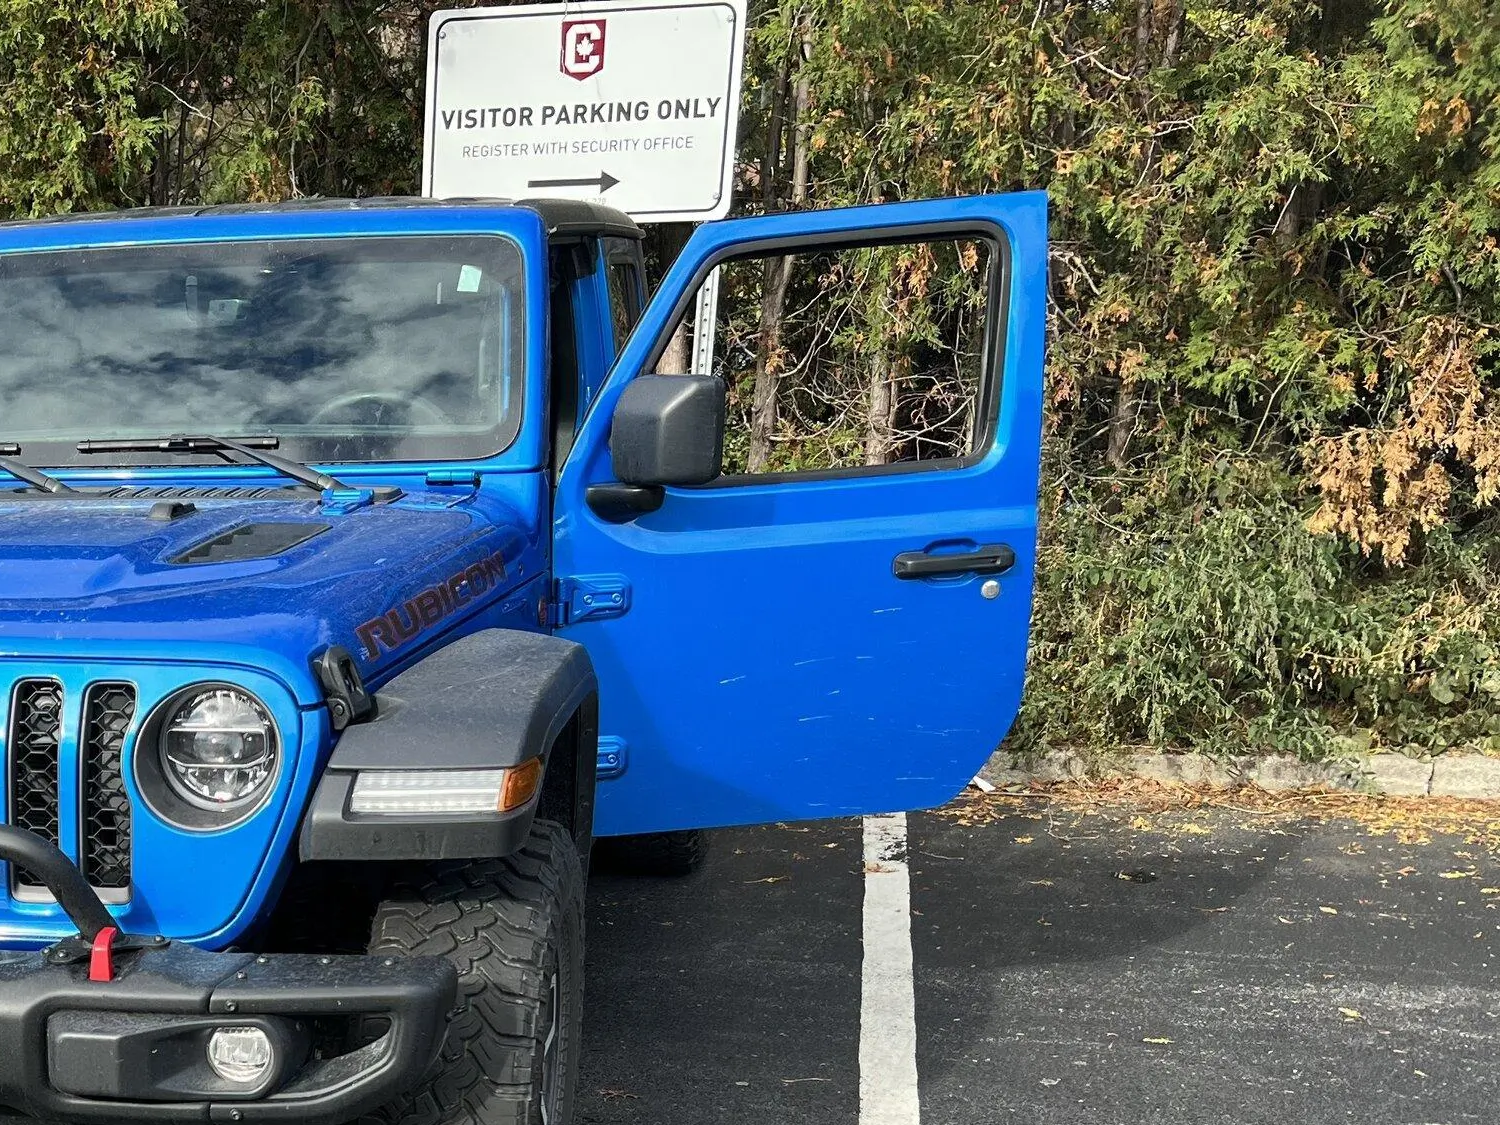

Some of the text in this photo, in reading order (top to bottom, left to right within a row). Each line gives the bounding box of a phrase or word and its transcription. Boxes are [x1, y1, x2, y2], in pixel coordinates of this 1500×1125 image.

[564, 24, 602, 72] C
[442, 97, 721, 129] VISITOR PARKING ONLY
[462, 136, 694, 157] REGISTER WITH SECURITY OFFICE
[356, 552, 506, 661] RUBICON
